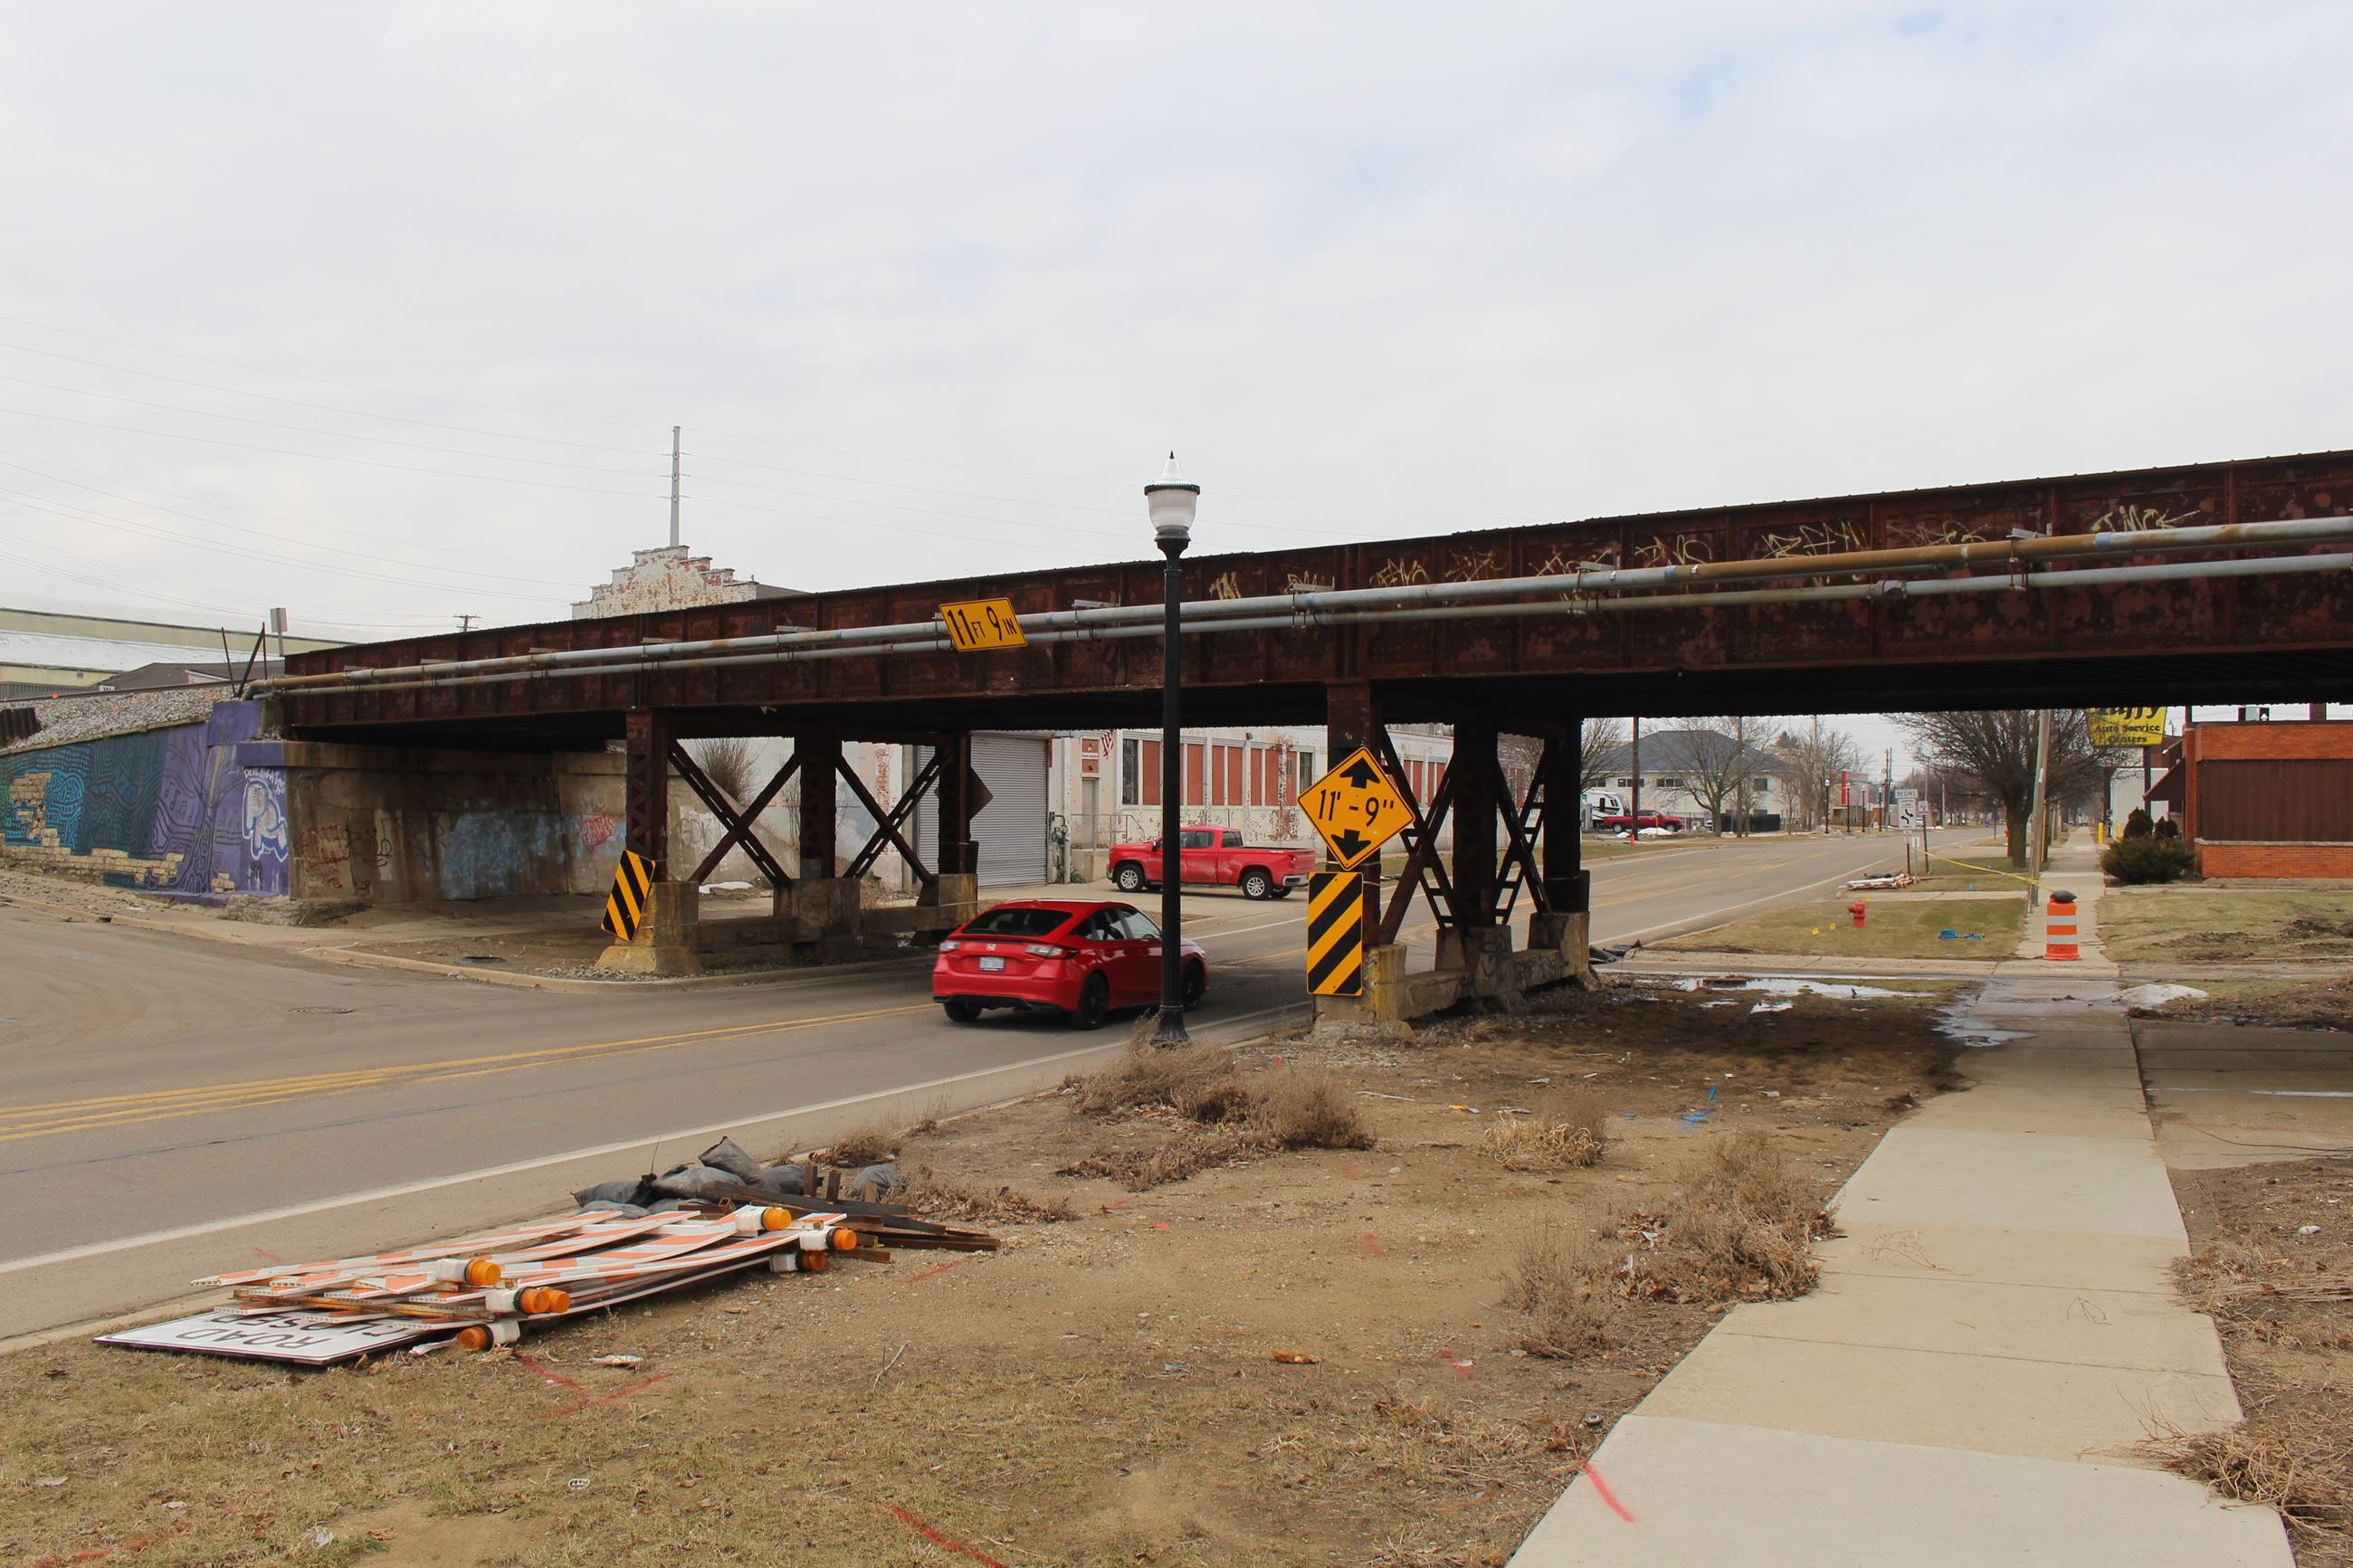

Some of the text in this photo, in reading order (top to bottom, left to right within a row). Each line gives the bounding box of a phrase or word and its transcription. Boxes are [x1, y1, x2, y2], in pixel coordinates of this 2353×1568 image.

[947, 606, 1017, 645] 11 FT 9 IN
[2095, 724, 2160, 733] Auto Service
[176, 1328, 334, 1349] ROAD
